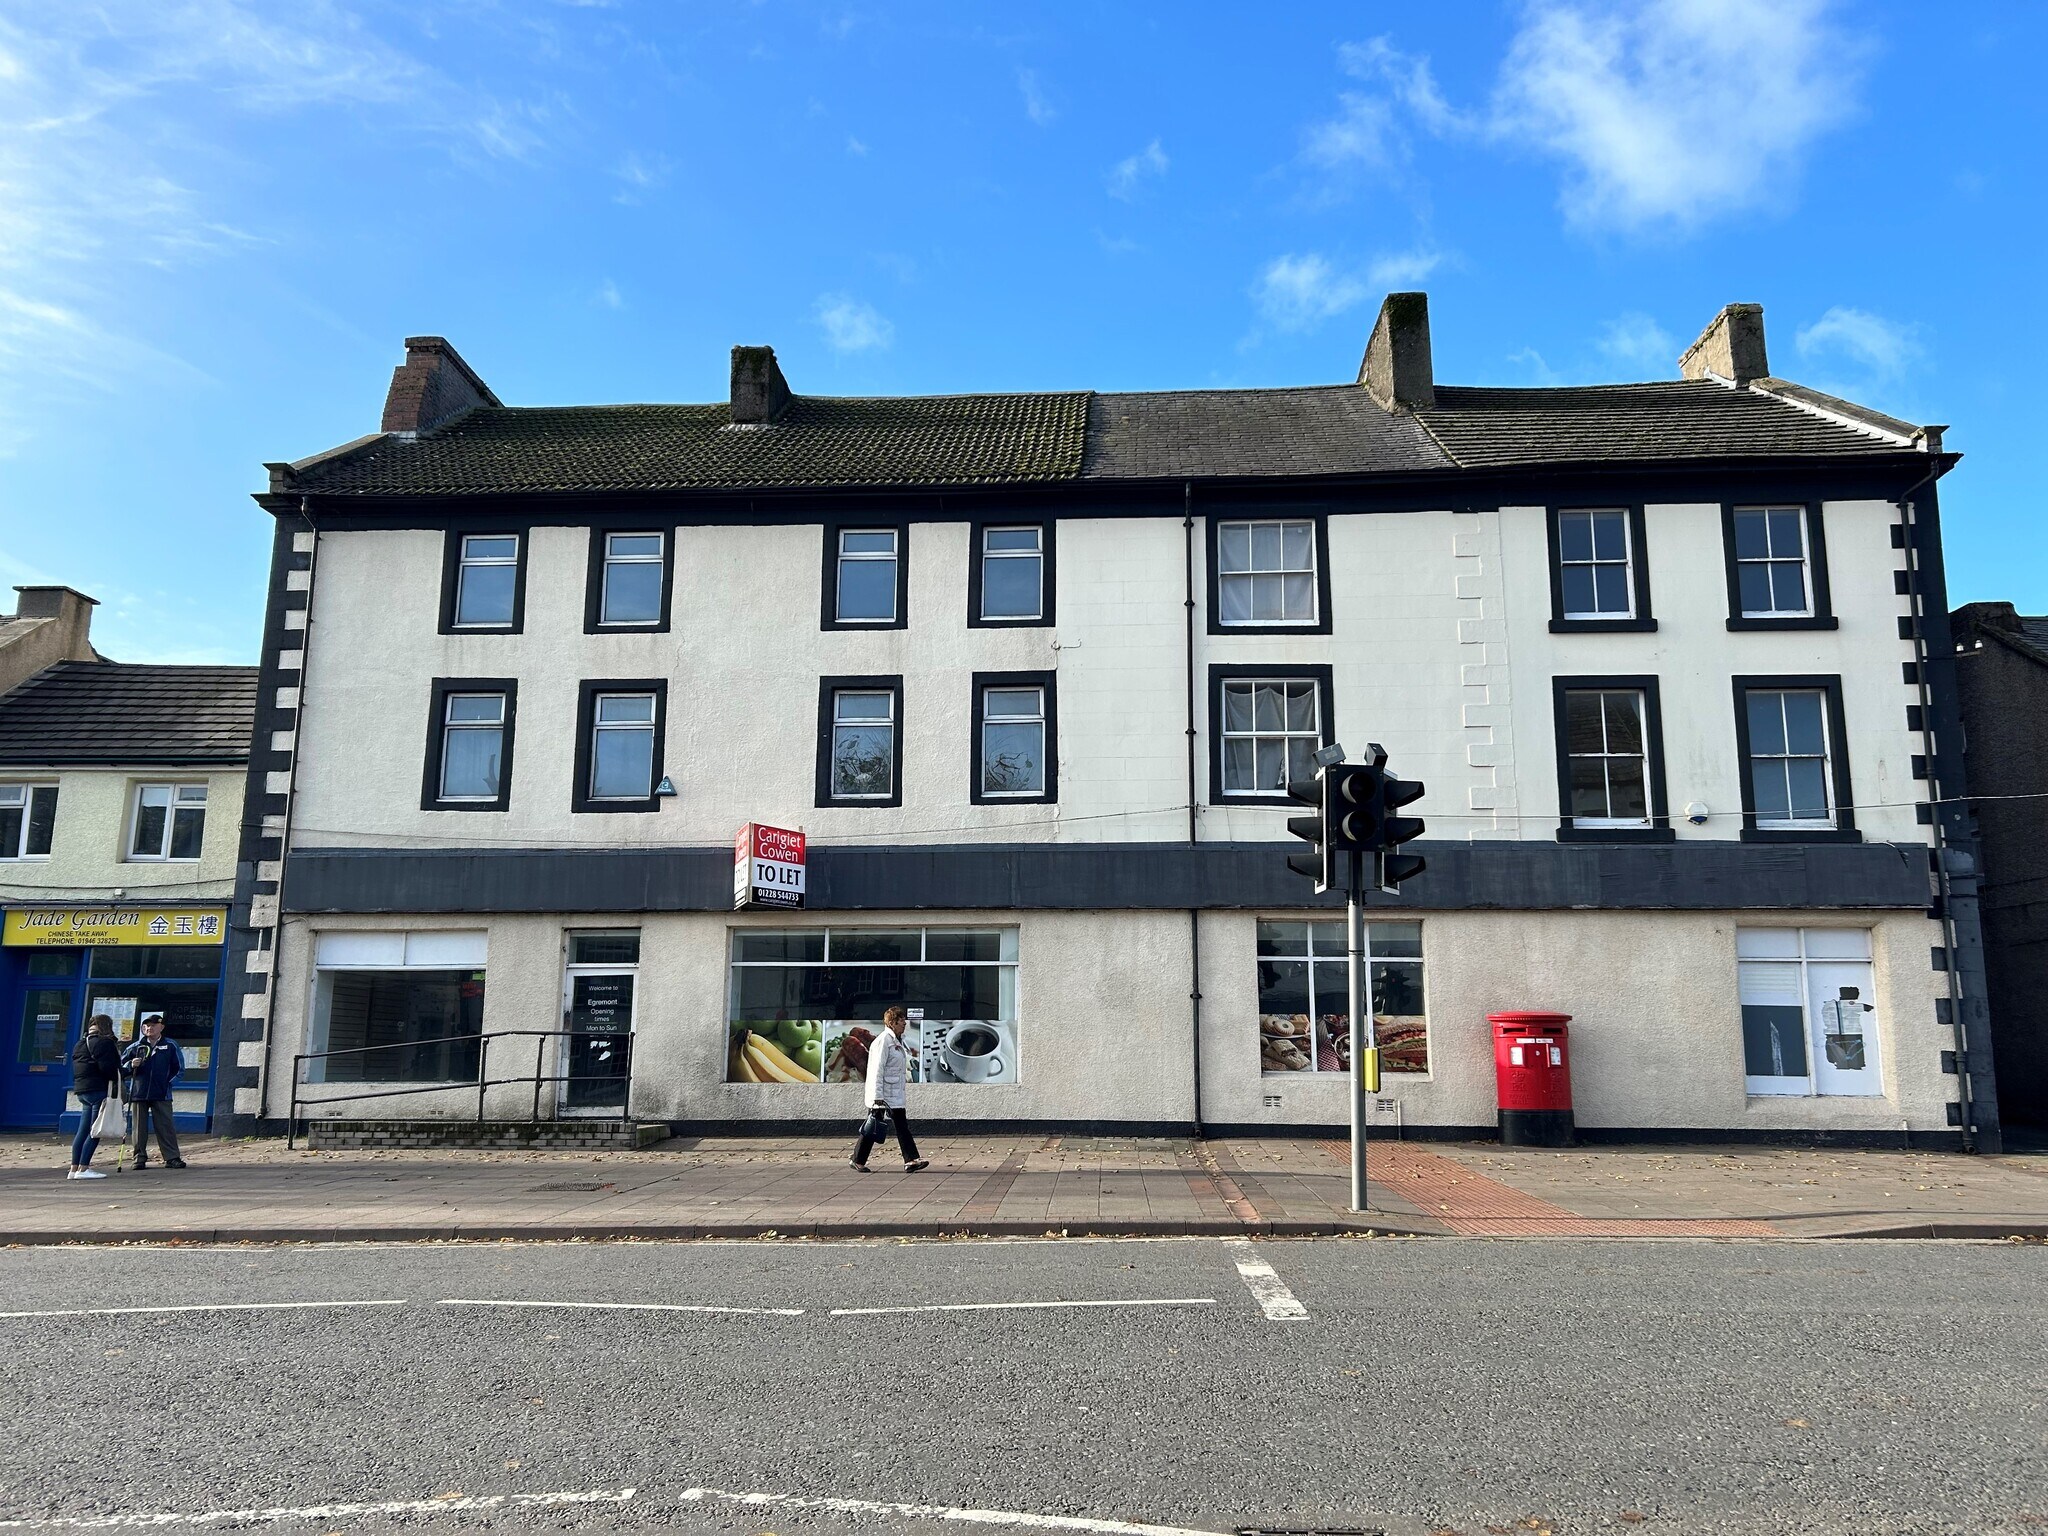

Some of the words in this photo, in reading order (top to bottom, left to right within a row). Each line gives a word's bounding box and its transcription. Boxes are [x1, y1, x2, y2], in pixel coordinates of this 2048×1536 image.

[758, 827, 801, 849] Carigiet
[760, 843, 798, 862] Cowen
[757, 864, 776, 882] TO
[779, 867, 801, 886] LET
[758, 888, 777, 899] 01228
[777, 890, 799, 902] 544733
[20, 910, 65, 929] Jade
[72, 910, 140, 930] Garden
[148, 915, 219, 935] 金玉樓
